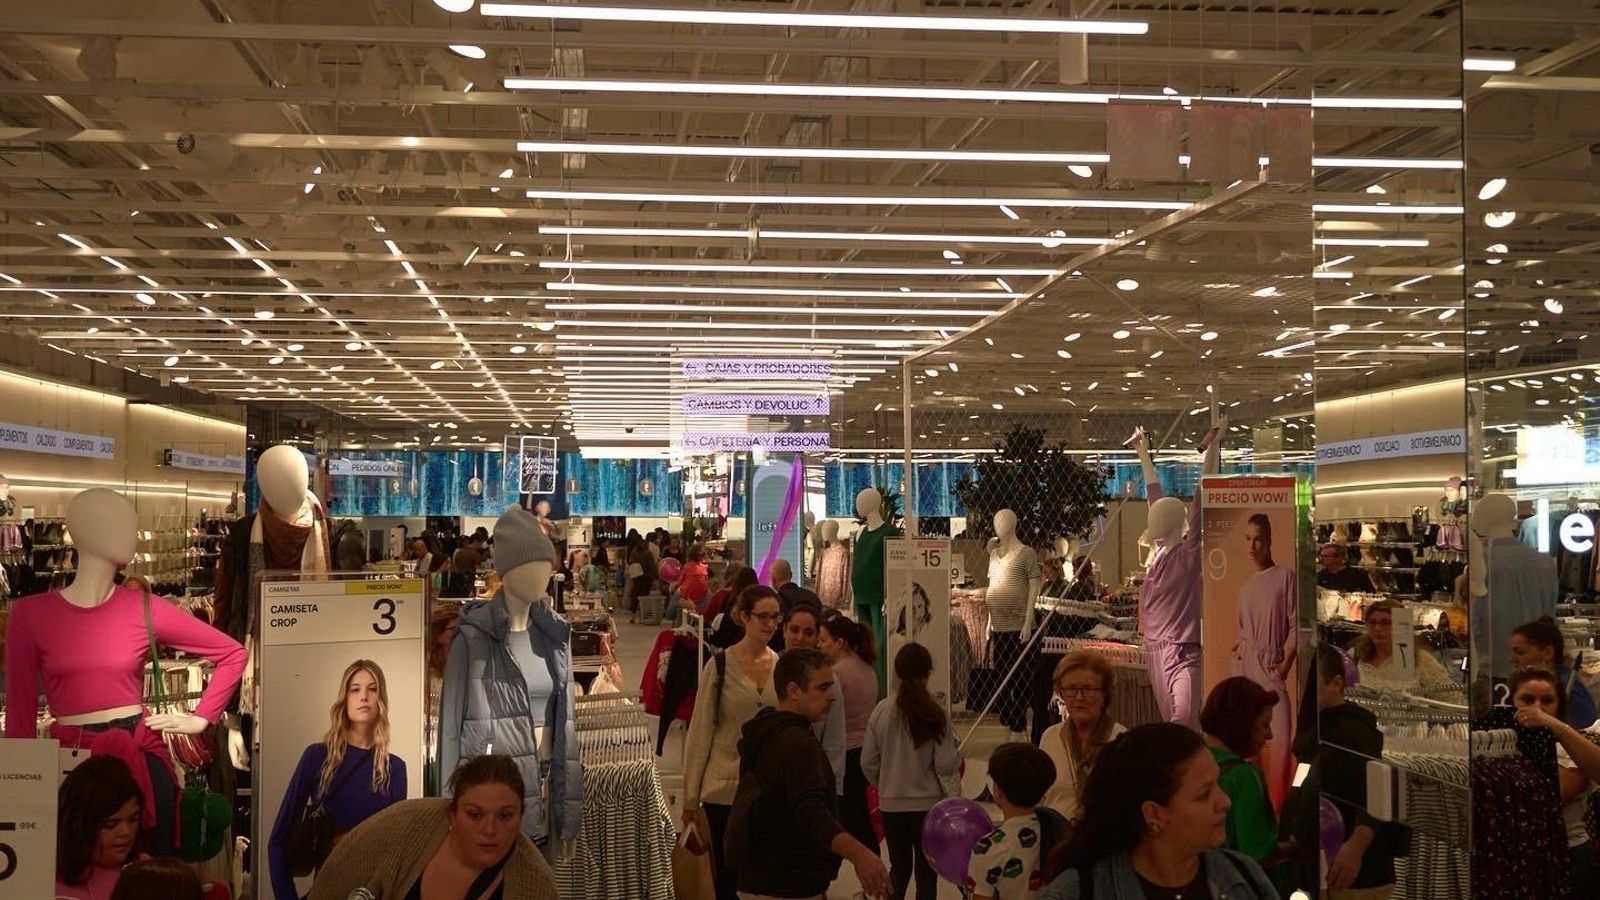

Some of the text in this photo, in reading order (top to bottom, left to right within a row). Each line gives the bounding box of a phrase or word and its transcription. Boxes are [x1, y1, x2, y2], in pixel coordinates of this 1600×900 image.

[705, 363, 831, 375] CAJAS Y PROBADORES
[688, 399, 808, 411] CAMBIOS Y DEVOLUC
[1208, 493, 1288, 503] PRECIO WOW!
[921, 550, 941, 567] 15
[1208, 548, 1228, 581] 9
[951, 568, 959, 580] 9
[270, 598, 396, 635] CAMISETA 3
[270, 618, 297, 627] CROP
[20, 822, 37, 830] 99€
